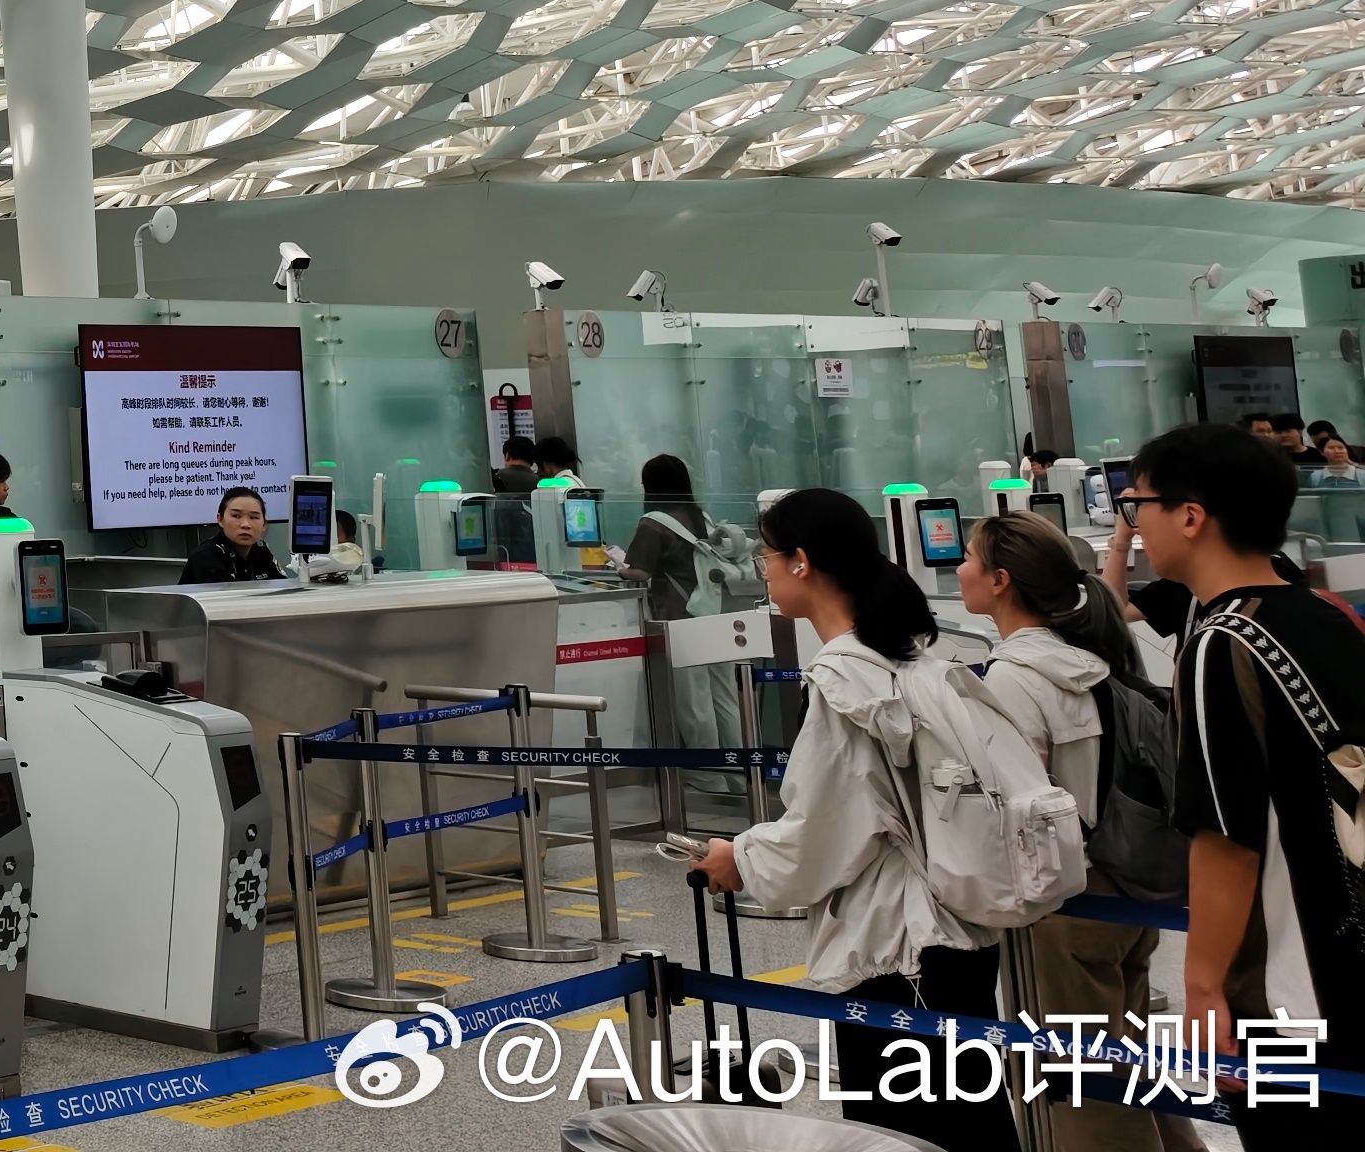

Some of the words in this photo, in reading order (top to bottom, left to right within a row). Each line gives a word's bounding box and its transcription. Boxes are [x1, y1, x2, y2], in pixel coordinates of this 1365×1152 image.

[439, 319, 462, 347] 27
[581, 321, 602, 348] 28
[180, 374, 217, 389] 温馨提示
[169, 441, 190, 454] Kind
[192, 440, 236, 453] Reminder
[125, 460, 146, 471] There
[148, 462, 160, 470] are
[162, 459, 179, 472] long
[181, 460, 208, 471] queues
[209, 457, 234, 470] during
[235, 457, 253, 470] peak
[148, 474, 173, 487] please
[174, 473, 184, 483] be
[216, 471, 239, 482] Thank
[240, 472, 256, 483] you!
[103, 490, 110, 500] If
[111, 492, 126, 502] you
[127, 490, 146, 499] need
[148, 489, 167, 500] help,
[169, 487, 193, 499] please
[194, 487, 205, 496] do
[206, 487, 219, 496] not
[260, 484, 287, 494] contact
[402, 747, 490, 762] 安全检查
[501, 752, 570, 763] SECURITY
[572, 753, 621, 764] CHECK
[443, 811, 470, 825] SECURITY
[470, 806, 490, 820] CHECK
[237, 879, 257, 905] 25
[510, 991, 562, 1019] CHECK
[57, 1084, 147, 1120] SECURITY
[146, 1073, 210, 1105] CHECK
[195, 1097, 278, 1120] DETECTION
[276, 1090, 314, 1105] AREA
